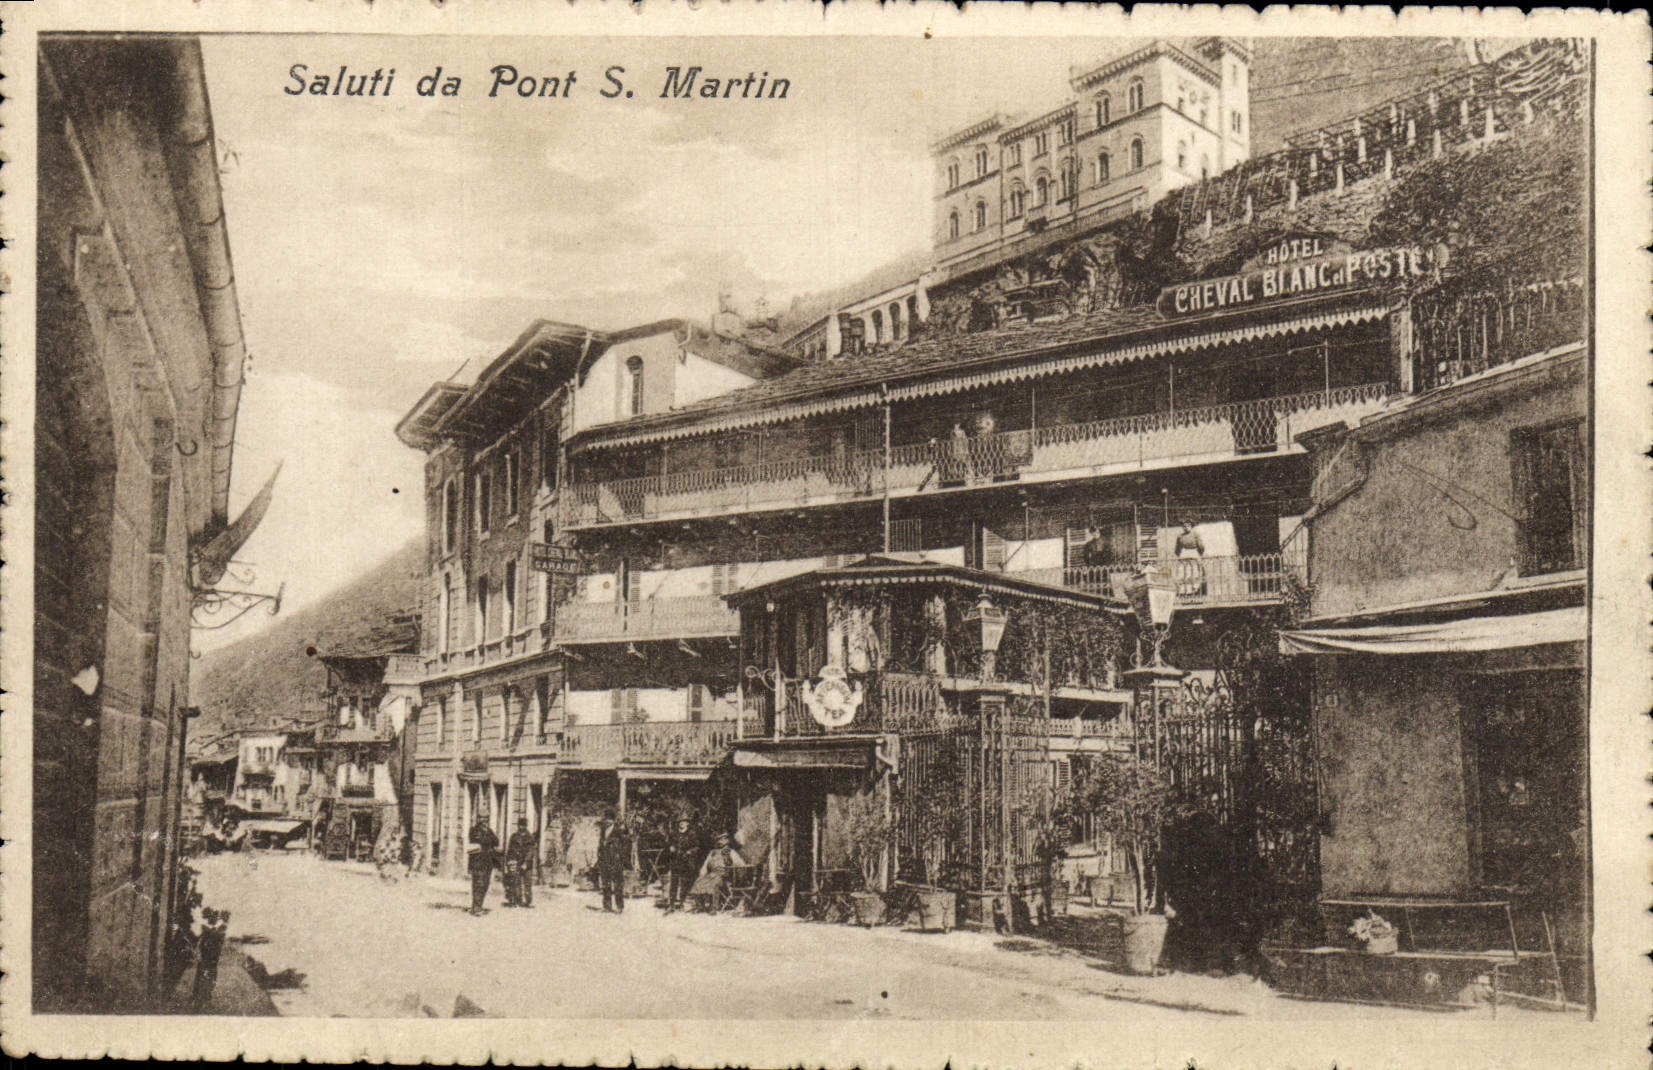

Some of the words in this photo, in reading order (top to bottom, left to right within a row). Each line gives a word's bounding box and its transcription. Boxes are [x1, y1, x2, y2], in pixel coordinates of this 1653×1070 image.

[1267, 238, 1324, 264] HÔTEL
[1174, 278, 1254, 313] CHEVAL
[1262, 262, 1331, 298] BLANC
